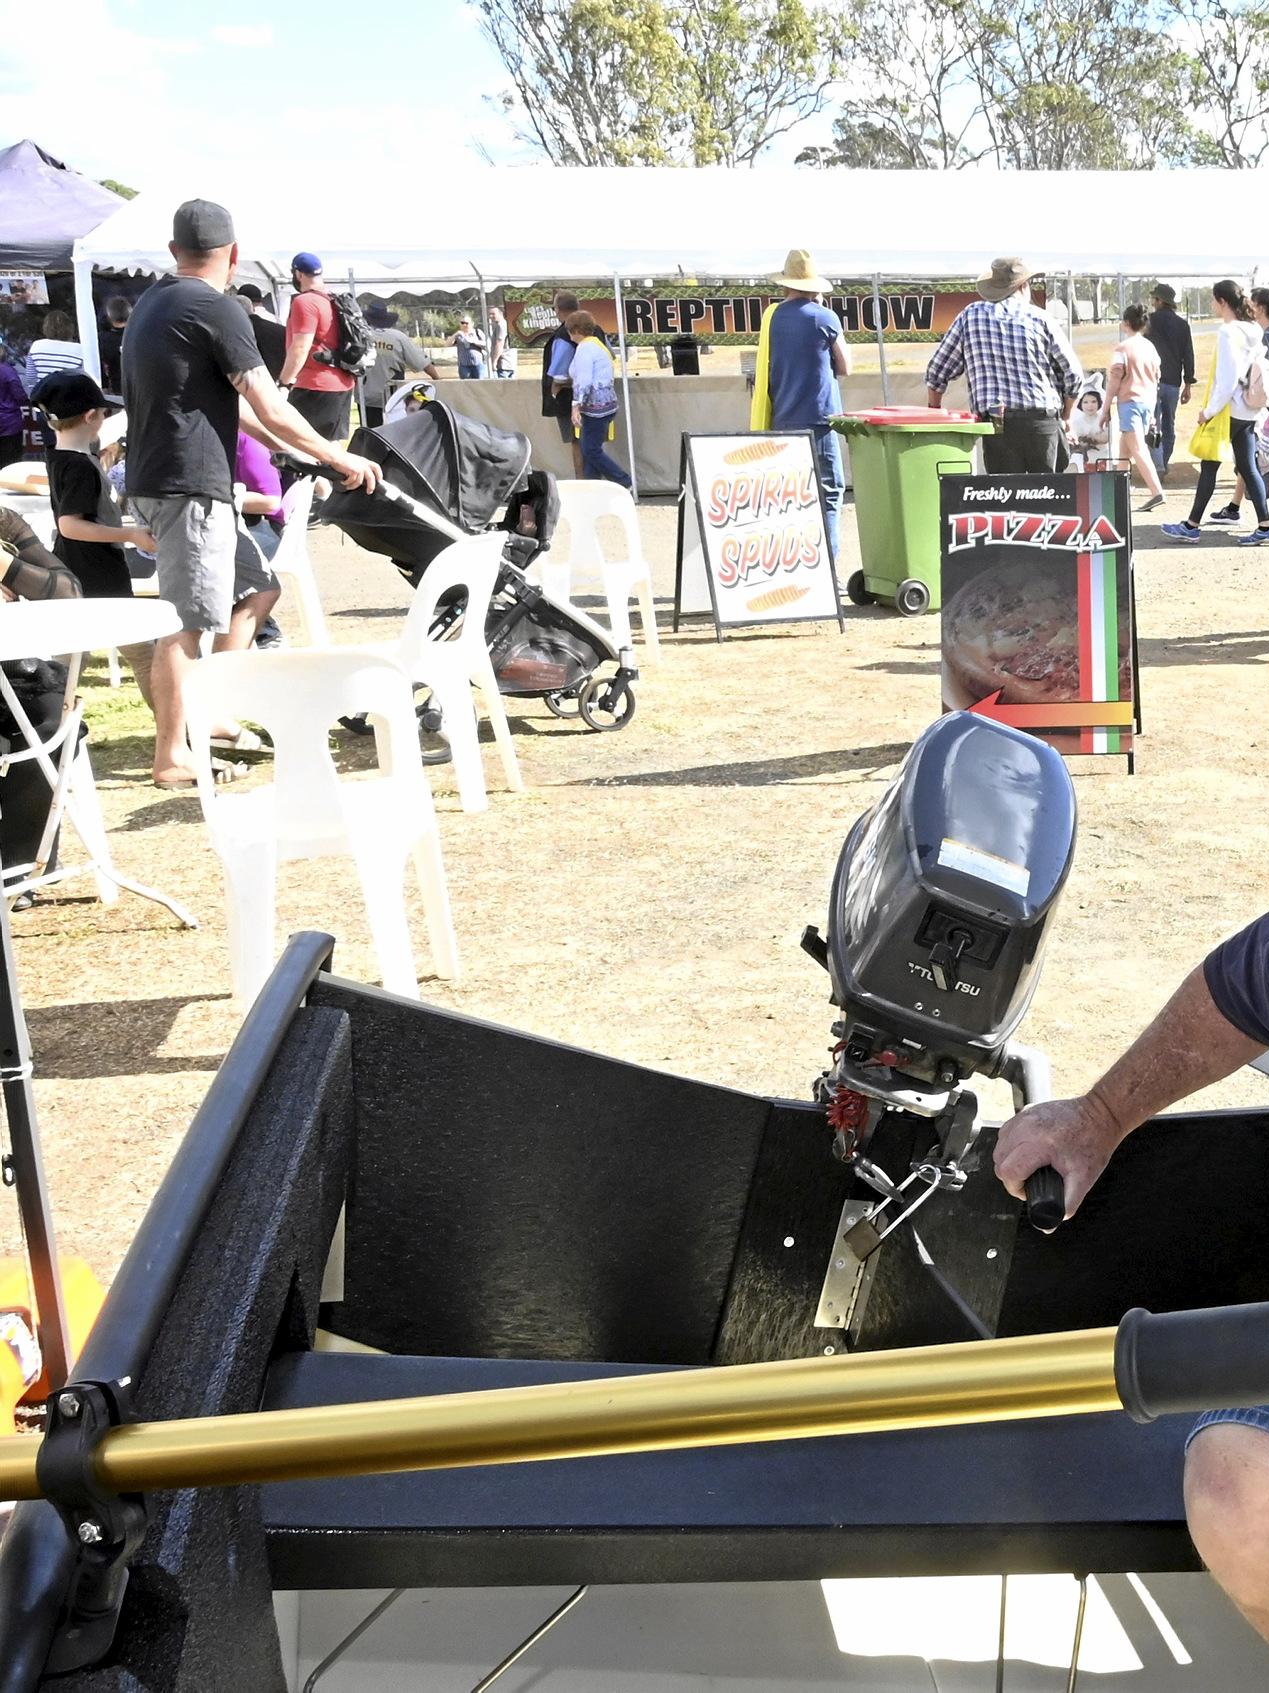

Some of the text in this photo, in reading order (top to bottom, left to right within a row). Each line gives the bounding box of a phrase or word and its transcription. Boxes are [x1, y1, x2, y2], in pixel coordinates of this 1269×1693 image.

[707, 471, 817, 528] SPIRAL
[963, 485, 1071, 503] Freshly made...
[718, 524, 822, 589] SPUDS
[948, 511, 1126, 554] PIZZA
